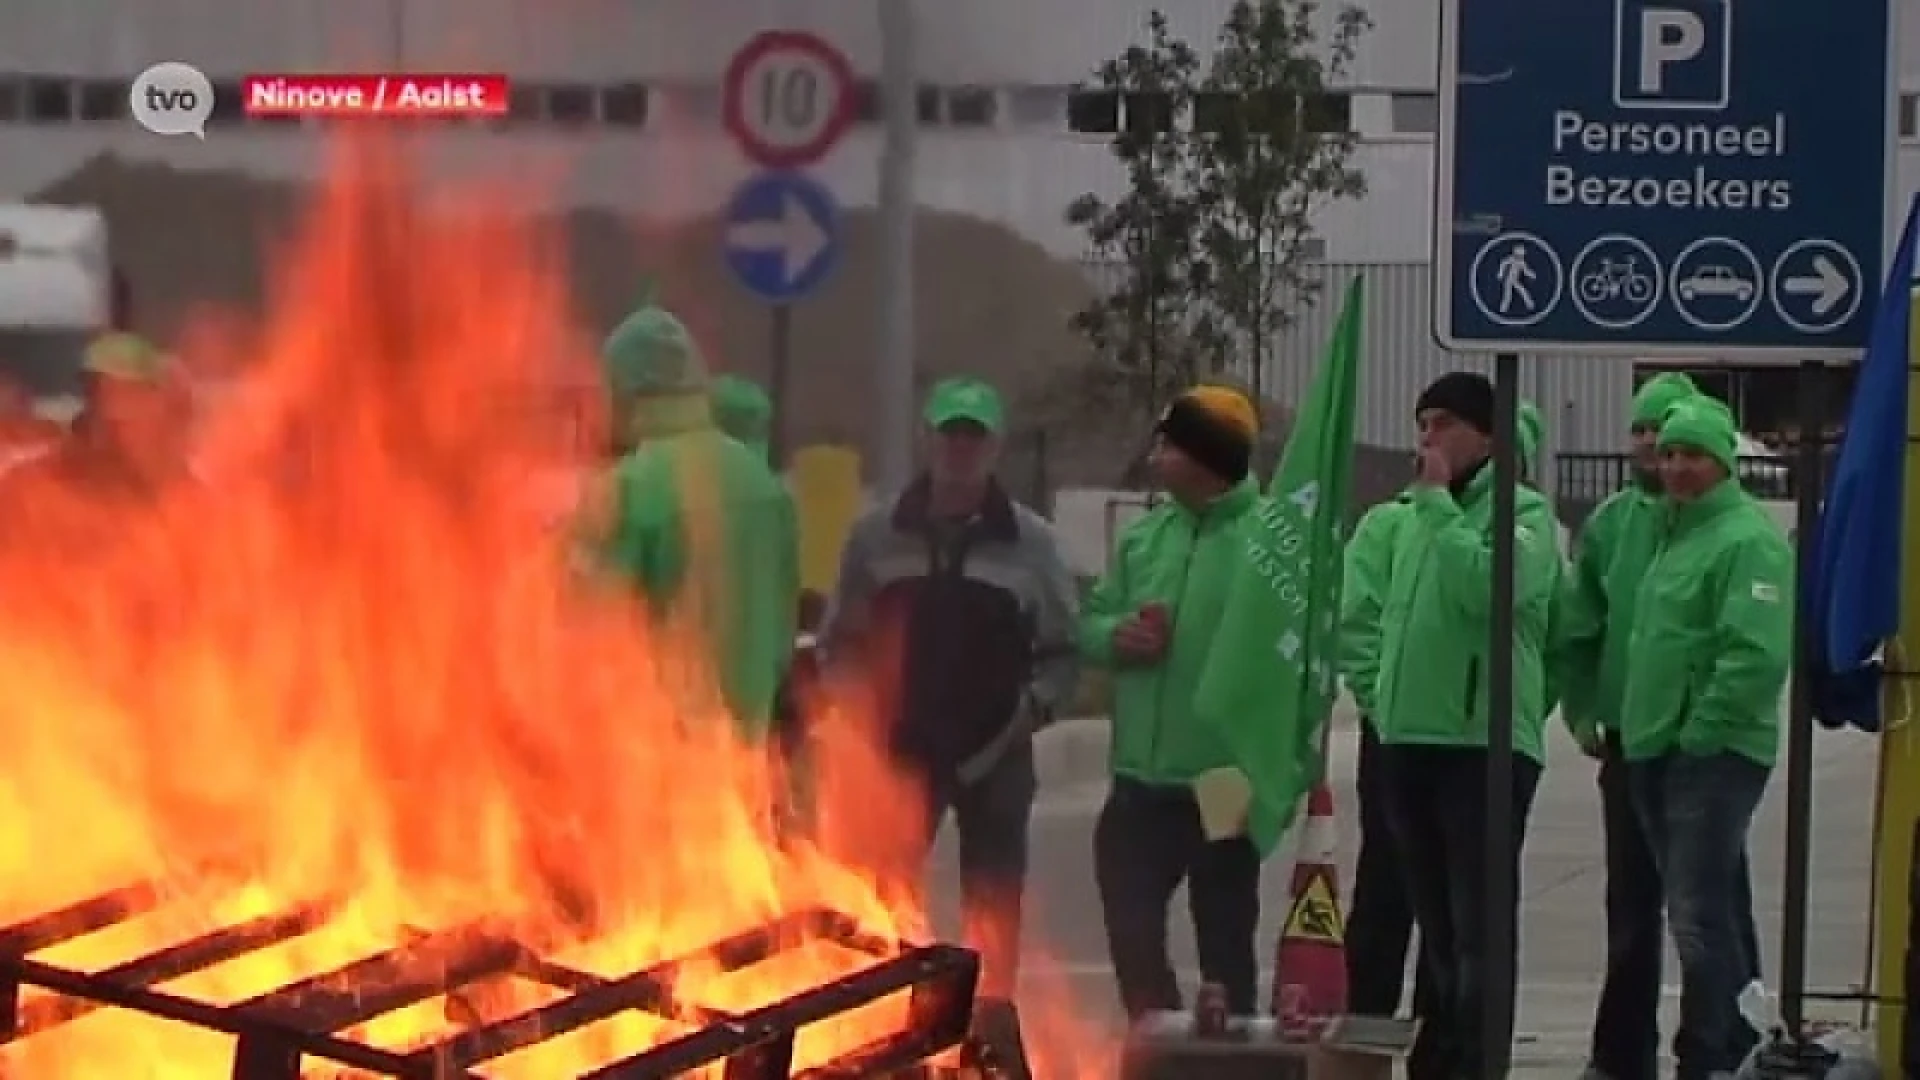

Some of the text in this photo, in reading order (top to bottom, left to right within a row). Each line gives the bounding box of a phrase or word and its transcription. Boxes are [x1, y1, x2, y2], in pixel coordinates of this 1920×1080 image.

[1640, 10, 1705, 92] P
[762, 66, 817, 128] 10
[1553, 110, 1785, 157] Personeel
[1547, 164, 1792, 210] Bezoekers
